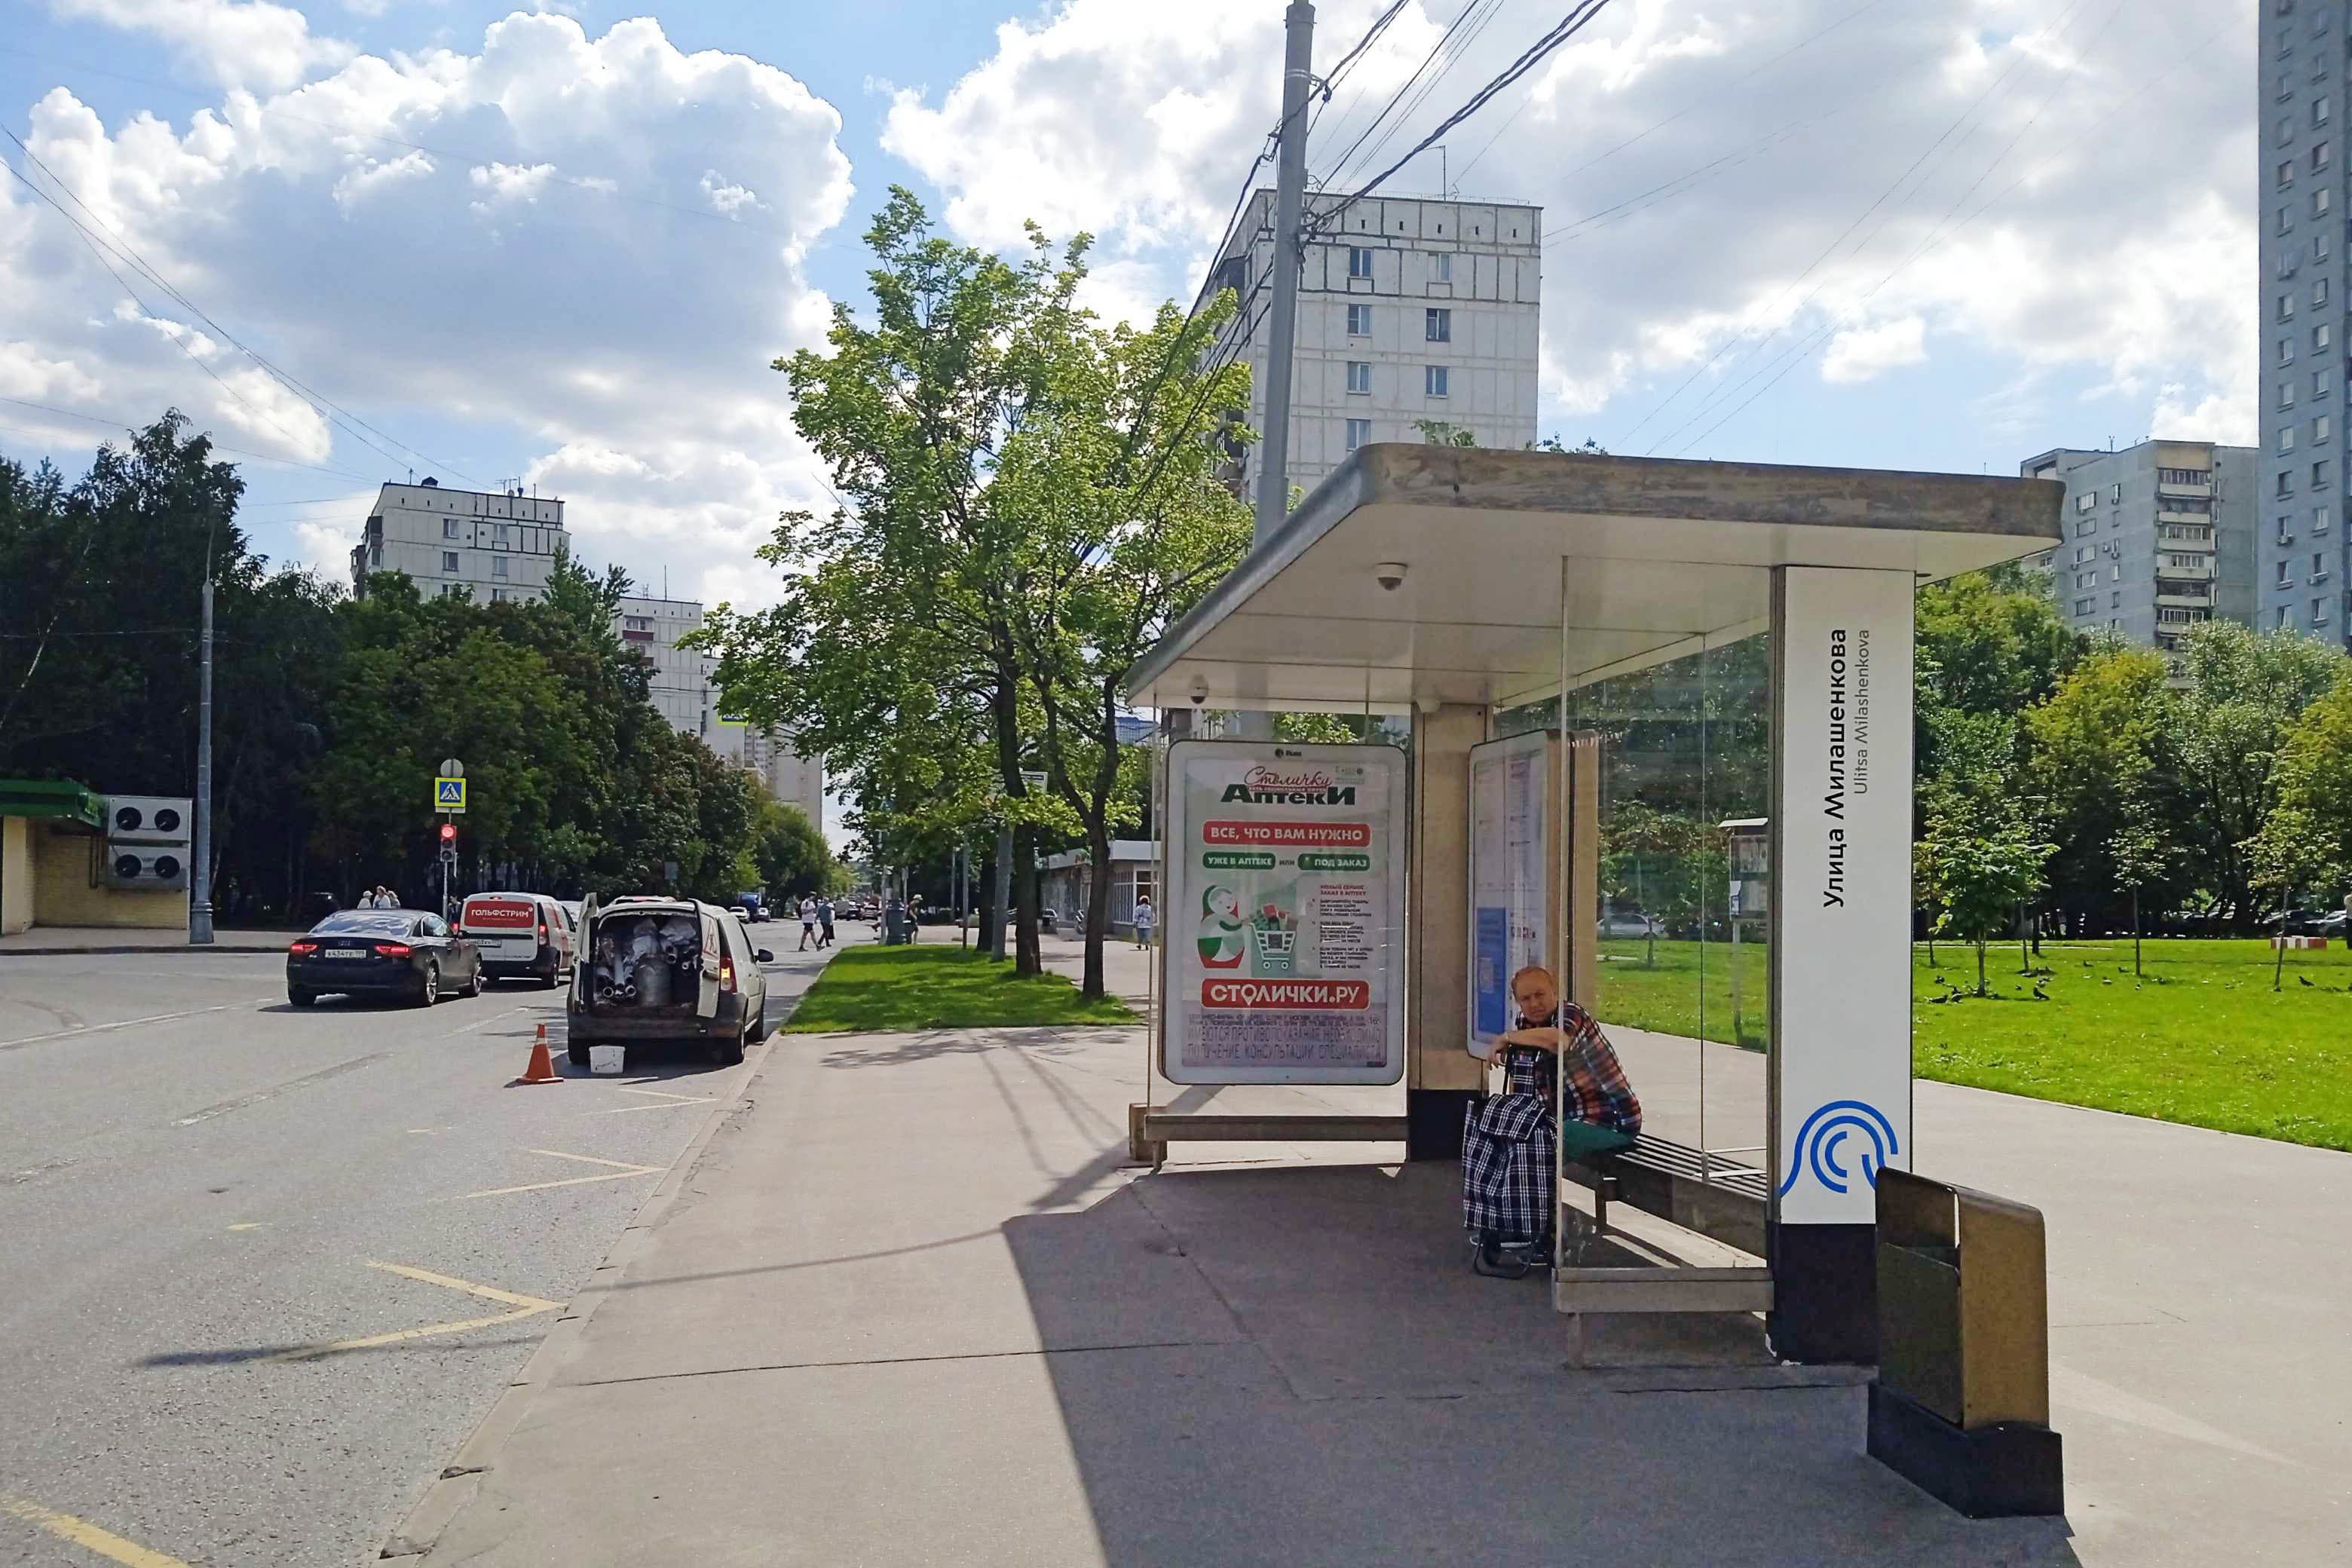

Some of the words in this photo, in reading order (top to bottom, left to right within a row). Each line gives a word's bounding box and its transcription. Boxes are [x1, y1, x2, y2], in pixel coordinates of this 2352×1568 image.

[1854, 629, 1870, 744] Milashenkova
[1824, 629, 1846, 820] Милашенкова
[1244, 766, 1332, 786] Столички
[1854, 749, 1869, 795] Ulitsa
[1211, 827, 1240, 840] ВСЕ,
[1244, 828, 1271, 839] ЧТО
[1275, 828, 1305, 840] ВАМ
[1309, 829, 1363, 841] НУЖНО
[1208, 856, 1228, 865] УЖЕ
[1238, 857, 1272, 865] АПТЕКЕ
[1314, 858, 1335, 867] ПОД
[1337, 859, 1367, 867] ЗАКАЗ
[1824, 828, 1847, 908] Улица
[471, 909, 529, 917] ГОЛЬФСТРИМ
[1210, 983, 1360, 1006] СТОЛИЧКИ.РУ
